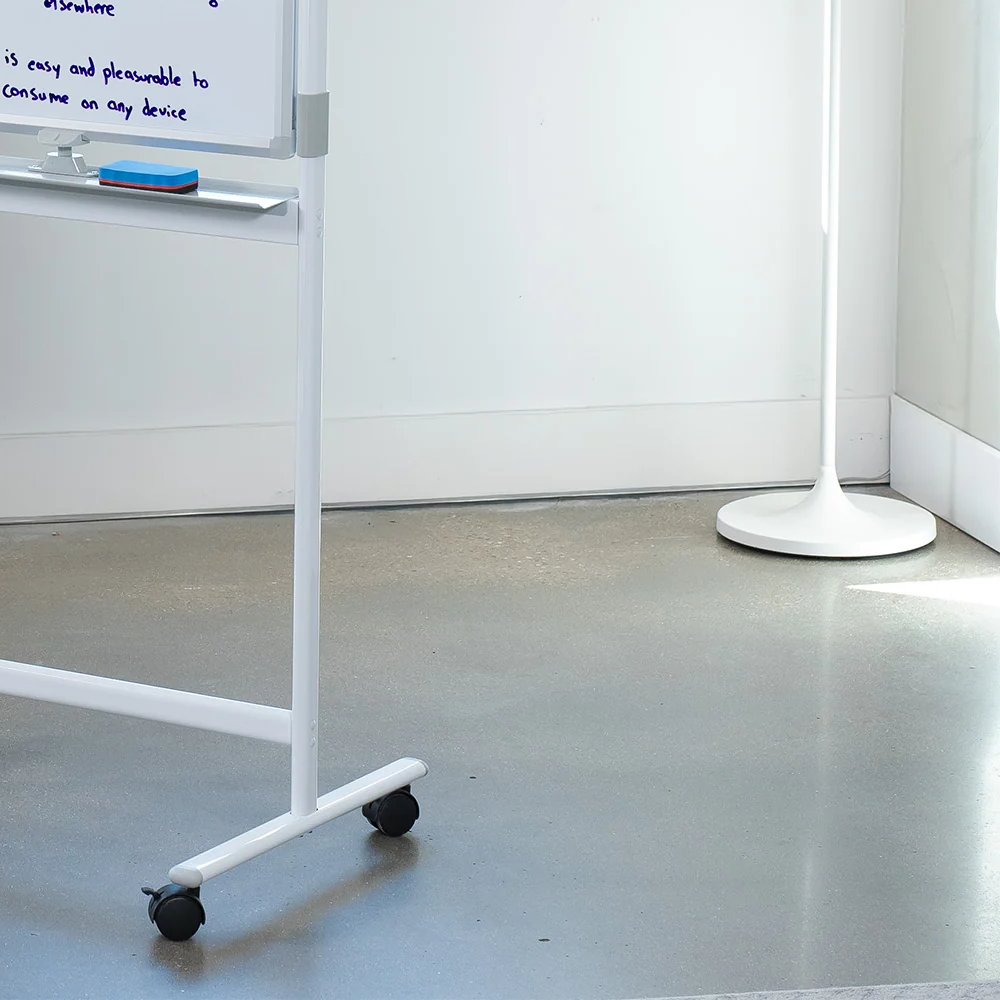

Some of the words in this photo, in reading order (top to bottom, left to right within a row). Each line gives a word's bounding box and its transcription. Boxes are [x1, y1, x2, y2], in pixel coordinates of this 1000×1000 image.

[5, 49, 18, 66] is
[28, 60, 60, 79] easy
[70, 57, 95, 77] and
[103, 61, 181, 86] pleasurable
[193, 71, 208, 89] to
[2, 84, 69, 104] consume
[81, 99, 98, 110] on
[107, 100, 133, 120] any
[142, 97, 187, 121] device
